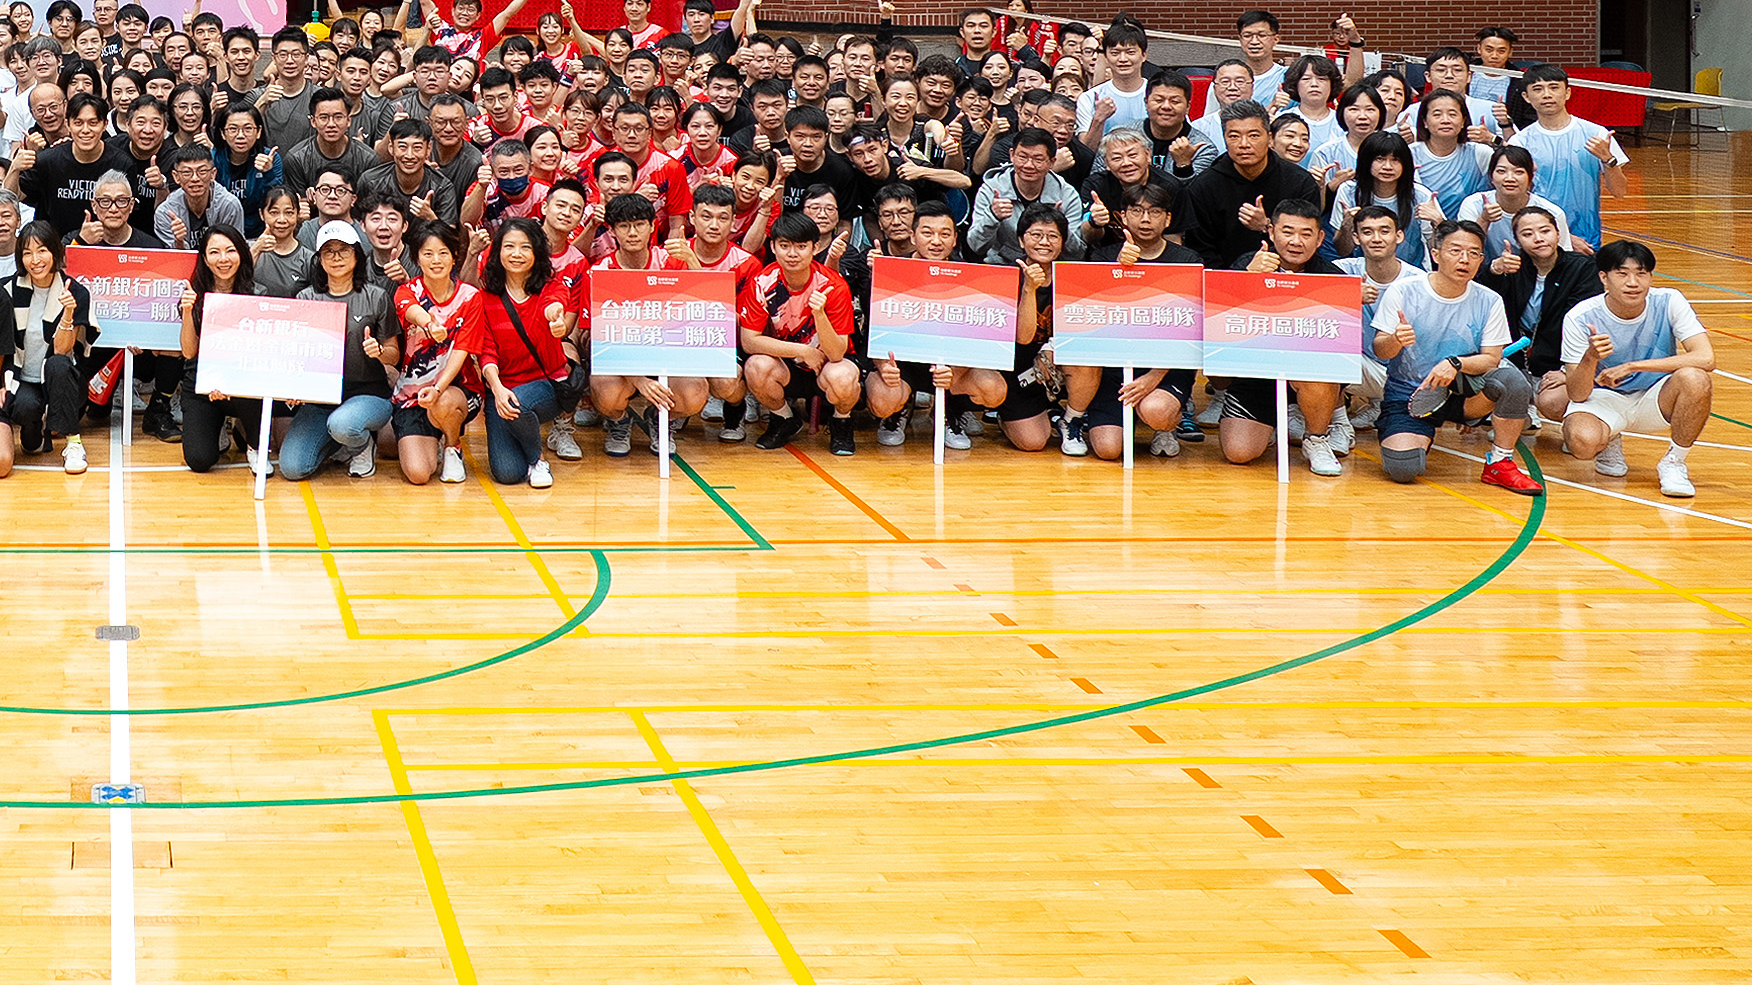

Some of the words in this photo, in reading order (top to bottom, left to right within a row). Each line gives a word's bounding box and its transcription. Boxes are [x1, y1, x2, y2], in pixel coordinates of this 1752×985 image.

[93, 300, 183, 322] 區第一聯
[600, 299, 728, 322] 台新銀行個金
[880, 298, 1008, 329] 中彰投區聯隊
[1063, 303, 1196, 328] 雲嘉南區聯隊
[238, 317, 309, 337] 台新銀行
[600, 324, 728, 347] 北區第二聯隊
[1224, 314, 1341, 340] 高屏區聯隊
